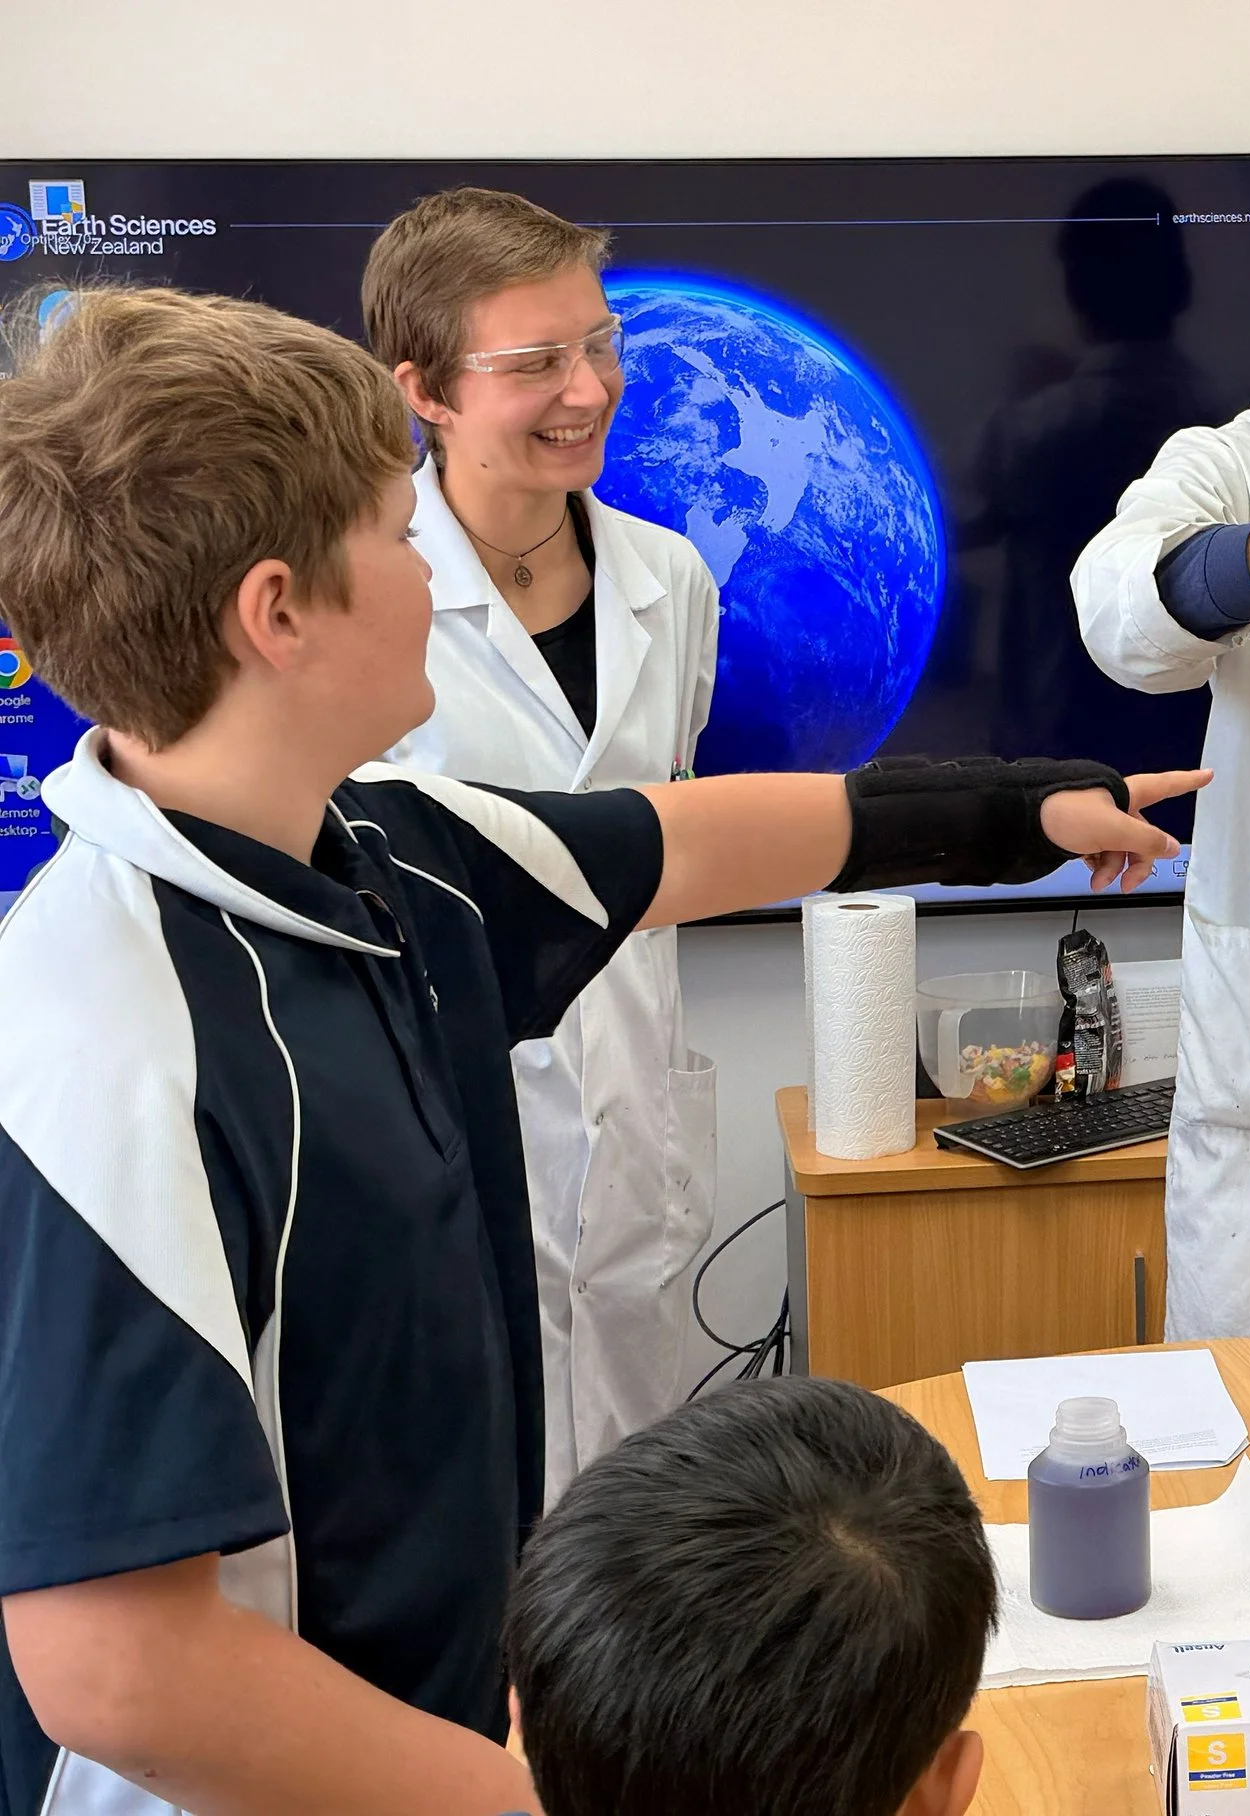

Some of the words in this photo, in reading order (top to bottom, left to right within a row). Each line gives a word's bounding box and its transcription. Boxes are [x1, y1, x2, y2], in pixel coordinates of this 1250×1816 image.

[43, 215, 106, 236] Earth
[109, 214, 217, 236] Sciences
[43, 238, 85, 255] New
[90, 237, 163, 255] Zealand
[0, 694, 31, 709] oogle
[0, 714, 34, 724] rome
[0, 808, 40, 818] emote
[1207, 1740, 1228, 1766] S
